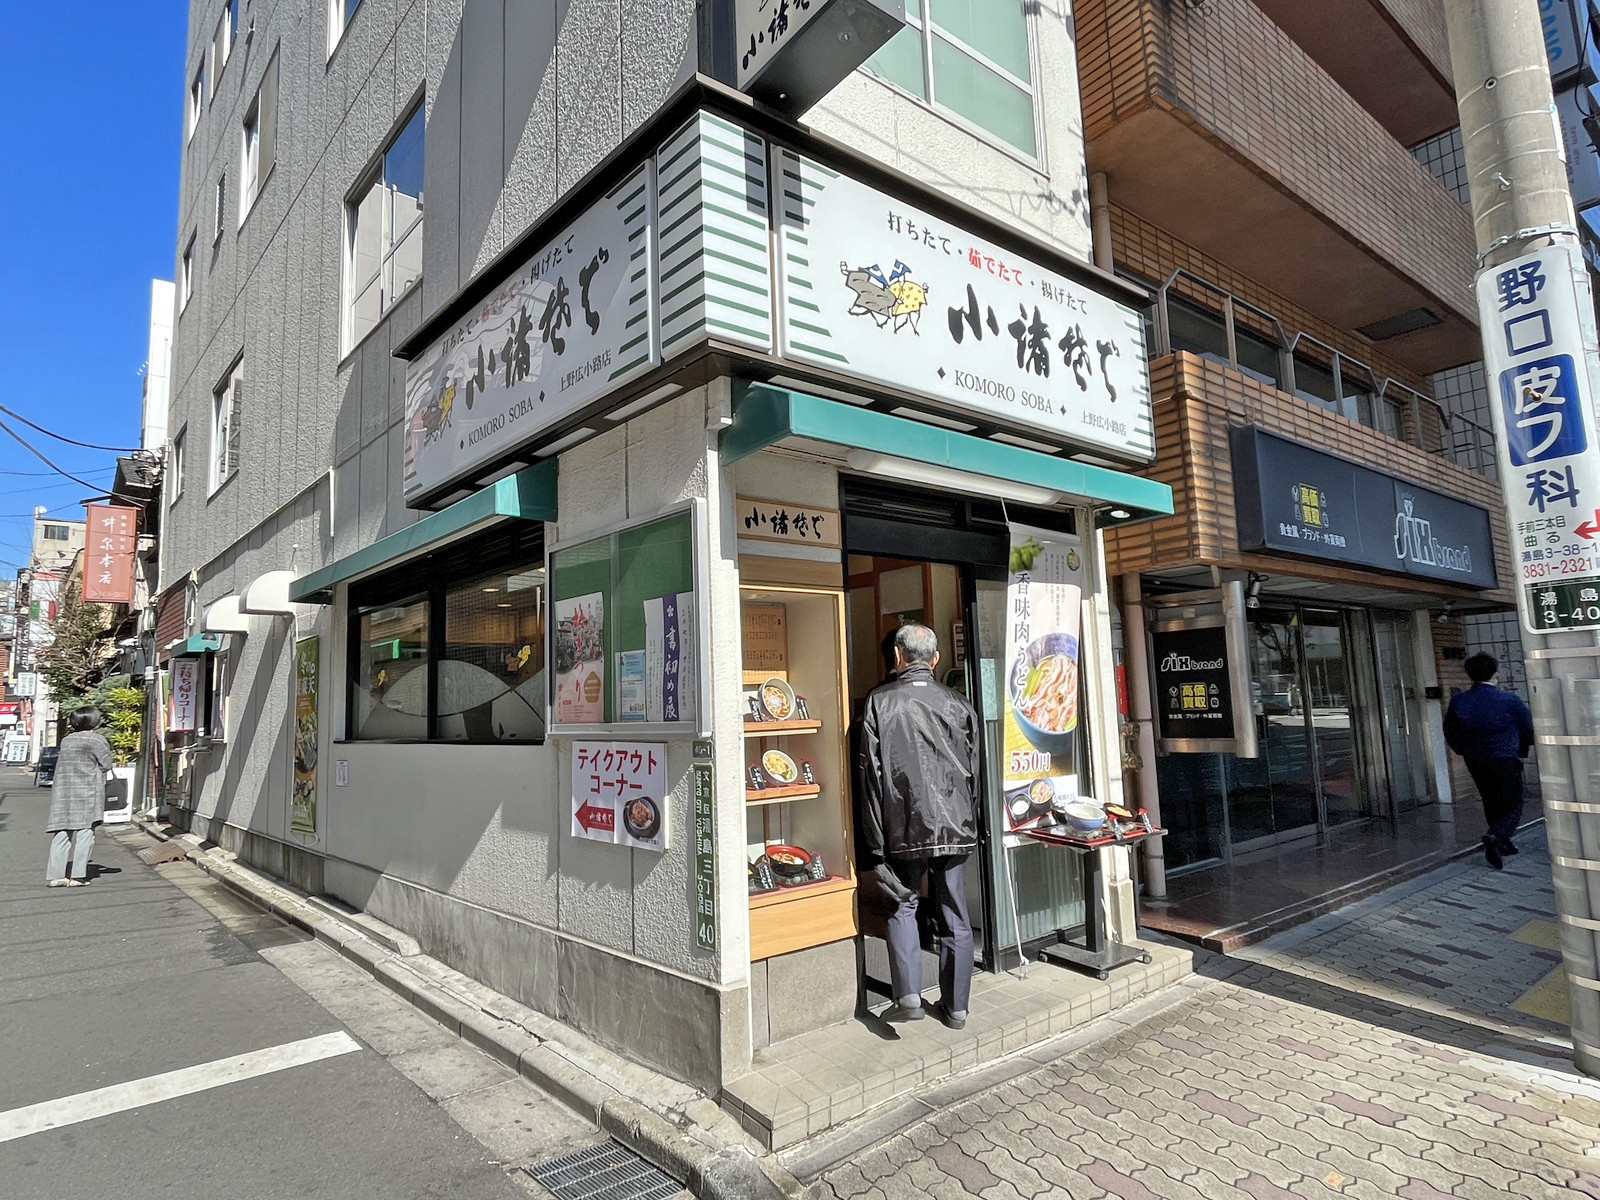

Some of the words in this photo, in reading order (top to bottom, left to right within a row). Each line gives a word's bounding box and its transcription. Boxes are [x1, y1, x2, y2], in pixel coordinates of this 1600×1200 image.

[558, 350, 612, 393] 上野広小路店
[955, 370, 1016, 402] KOMORO
[1021, 391, 1053, 414] SOBA
[1497, 260, 1581, 513] 野口皮フ科
[468, 413, 506, 448] KOMORO
[508, 397, 534, 423] SOBA
[1081, 410, 1127, 436] 上野広小路店
[1518, 515, 1566, 534] 手前三本目
[1523, 557, 1593, 578] 3831-2321
[1540, 588, 1599, 606] 湯島
[1543, 606, 1600, 624] 3-40
[1014, 572, 1031, 708] 香味肉うどん
[1191, 658, 1224, 670] brand
[577, 748, 658, 775] テイクアウト
[1010, 750, 1051, 773] 550円
[590, 773, 643, 797] コーナー
[699, 922, 714, 945] 40
